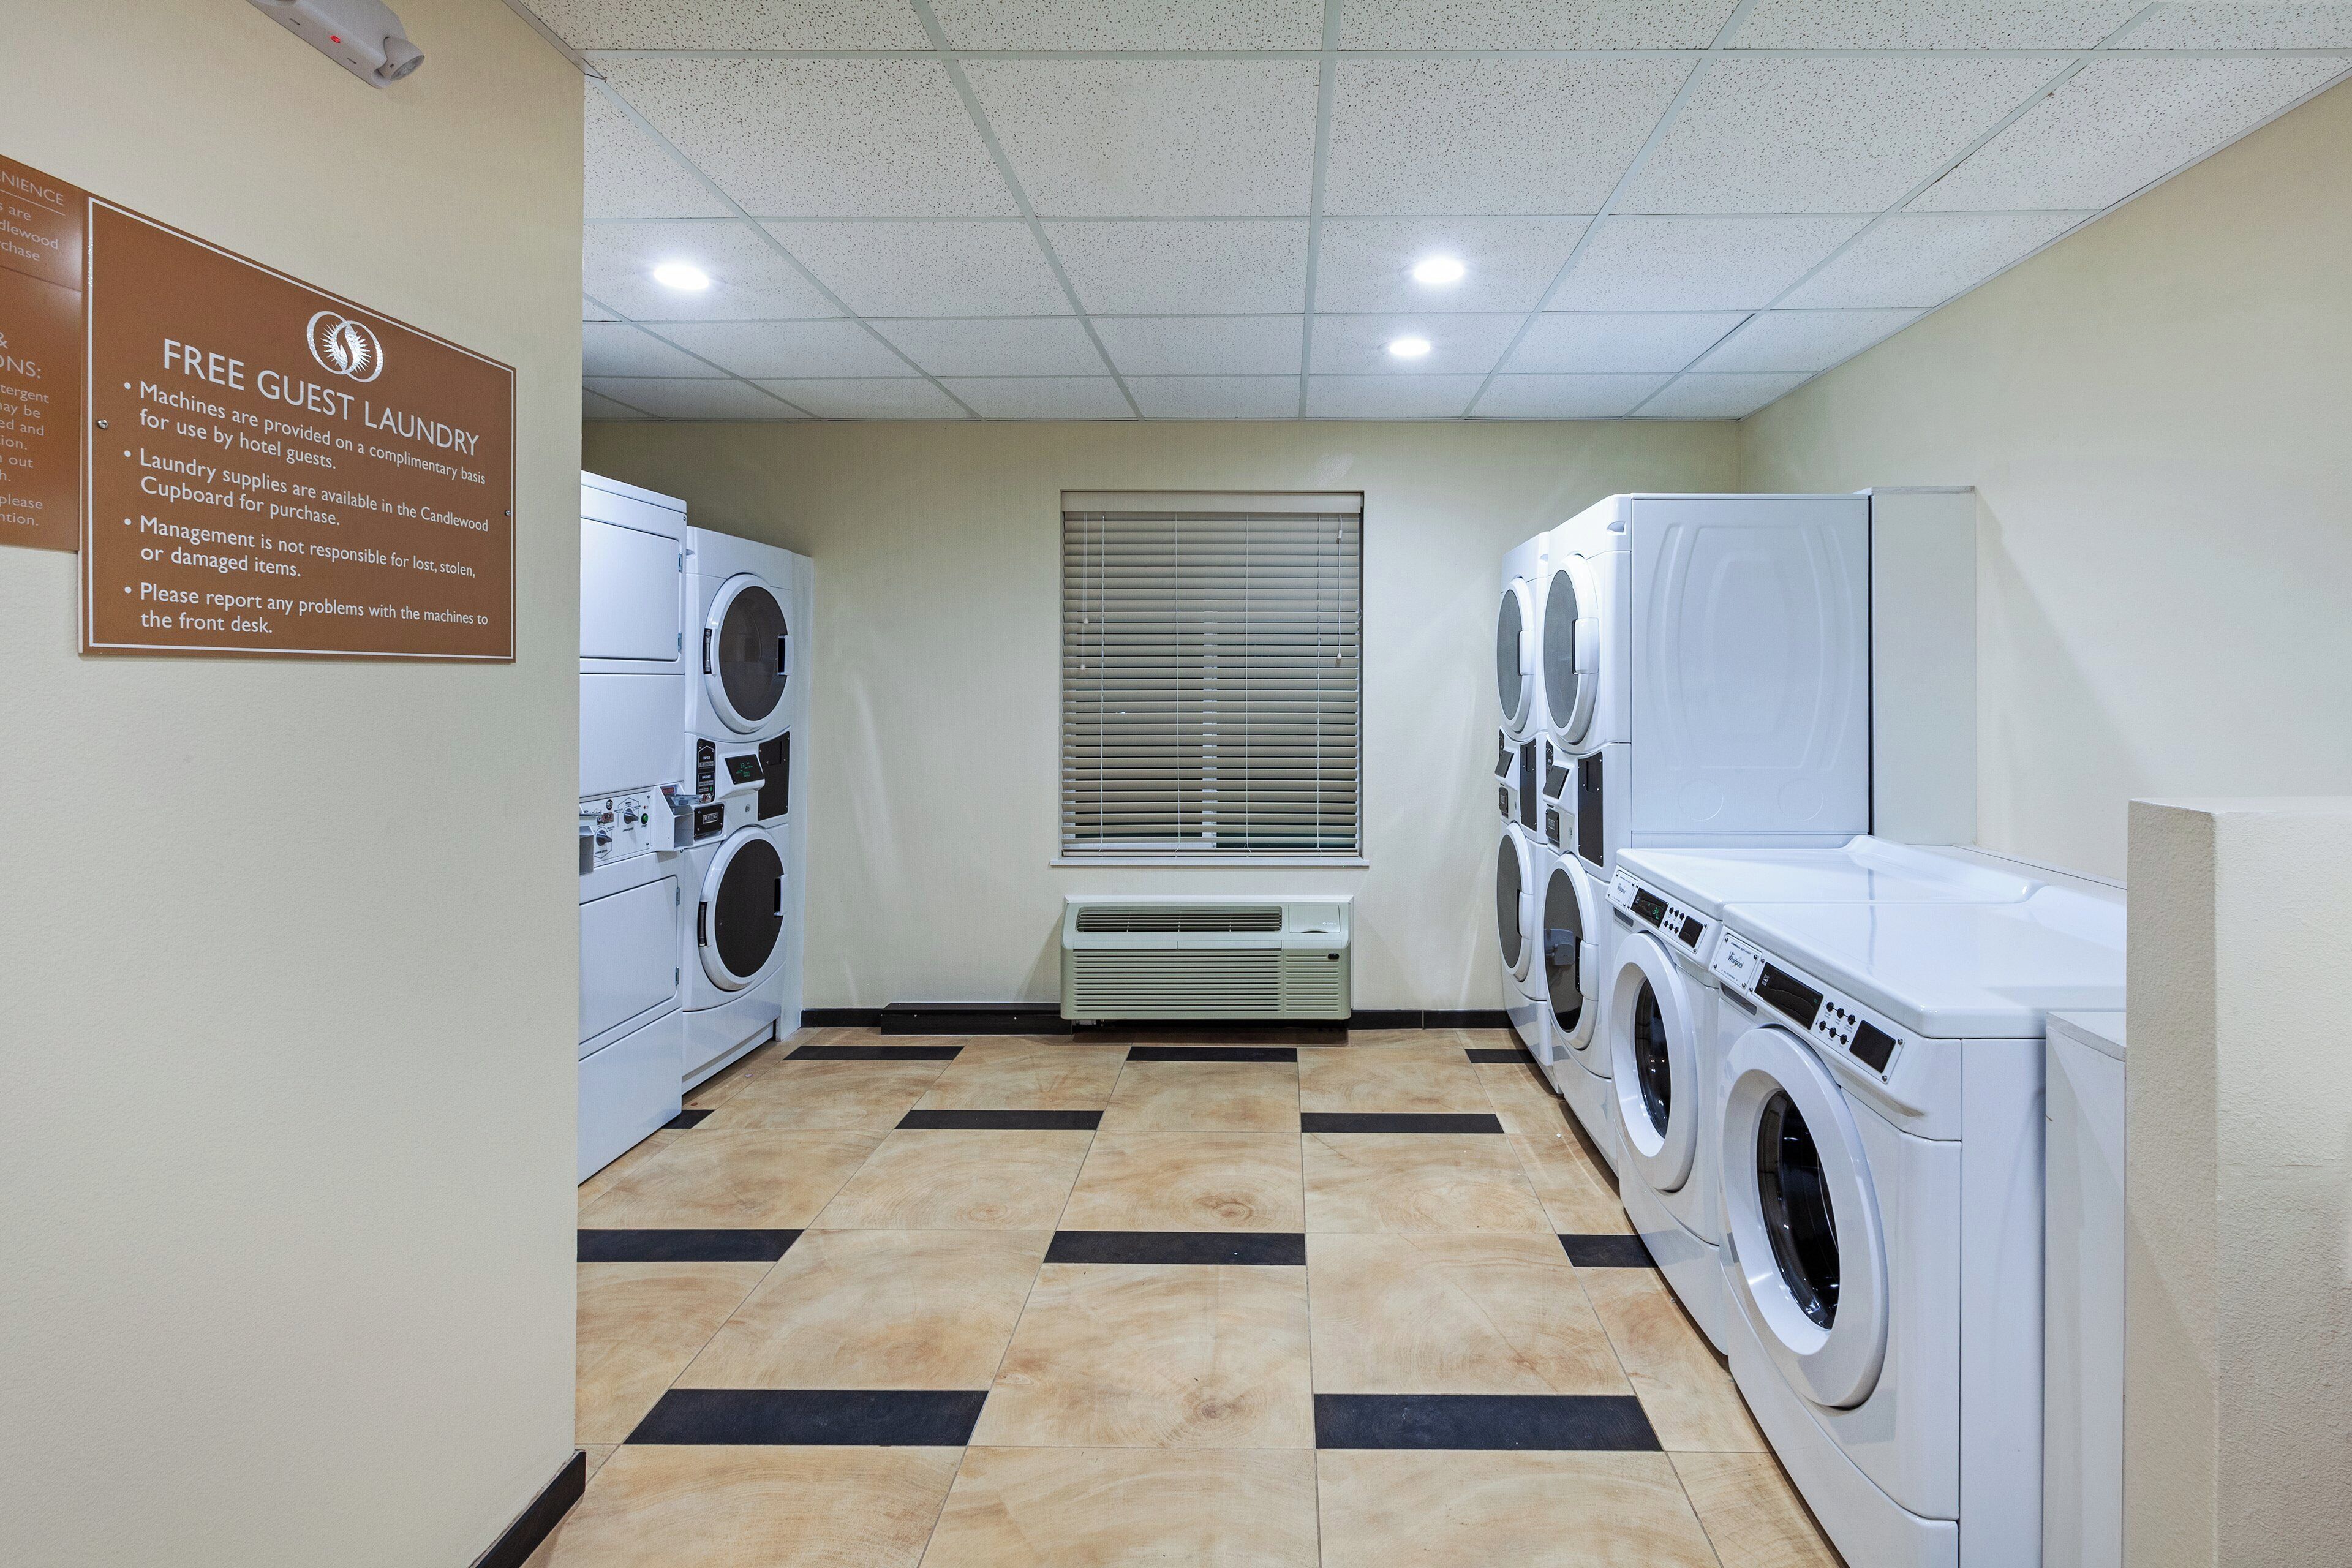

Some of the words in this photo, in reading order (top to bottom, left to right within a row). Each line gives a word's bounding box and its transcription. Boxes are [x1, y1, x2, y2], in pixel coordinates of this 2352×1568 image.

[0, 171, 64, 206] NIENCE
[9, 206, 31, 221] are
[0, 241, 40, 261] chase
[0, 385, 49, 404] tergent
[164, 337, 244, 391] FREE
[257, 369, 355, 420] GUEST
[364, 401, 480, 456] LAUNDRY
[0, 402, 18, 416] ay
[24, 404, 40, 418] be
[20, 423, 44, 436] and
[140, 380, 226, 419] Machines
[232, 410, 258, 428] are
[264, 418, 330, 446] provided
[335, 438, 353, 451] on
[358, 443, 365, 454] a
[369, 447, 458, 481] complimentary
[461, 466, 486, 484] basis
[140, 408, 170, 430] for
[176, 421, 207, 440] use
[214, 425, 234, 450] by
[239, 431, 281, 457] hotel
[286, 448, 336, 469] guests.
[0, 435, 28, 450] ion.
[9, 456, 34, 468] out
[140, 447, 217, 484] Laundry
[222, 470, 287, 493] supplies
[292, 484, 317, 499] are
[321, 490, 377, 510] available
[382, 499, 393, 514] in
[396, 502, 417, 518] the
[420, 506, 488, 532] Candlewood
[140, 475, 233, 508] Cupboard
[239, 493, 265, 512] for
[270, 503, 340, 526] purchase.
[0, 494, 43, 510] please
[140, 514, 255, 548] Management
[261, 533, 273, 550] is
[278, 540, 305, 554] not
[309, 545, 387, 565] responsible
[390, 552, 410, 568] for
[413, 555, 437, 573] lost,
[440, 562, 475, 579] stolen,
[140, 548, 164, 562] or
[170, 546, 248, 574] damaged
[255, 557, 301, 577] items.
[140, 582, 199, 604] Please
[206, 593, 262, 611] report
[267, 598, 294, 616] any
[299, 598, 364, 617] problems
[368, 603, 396, 619] with
[400, 605, 420, 620] the
[424, 609, 474, 624] machines
[477, 614, 488, 625] to
[140, 609, 173, 628] the
[179, 611, 225, 631] front
[230, 615, 273, 633] desk.
[1728, 955, 1744, 968] Whirlpool
